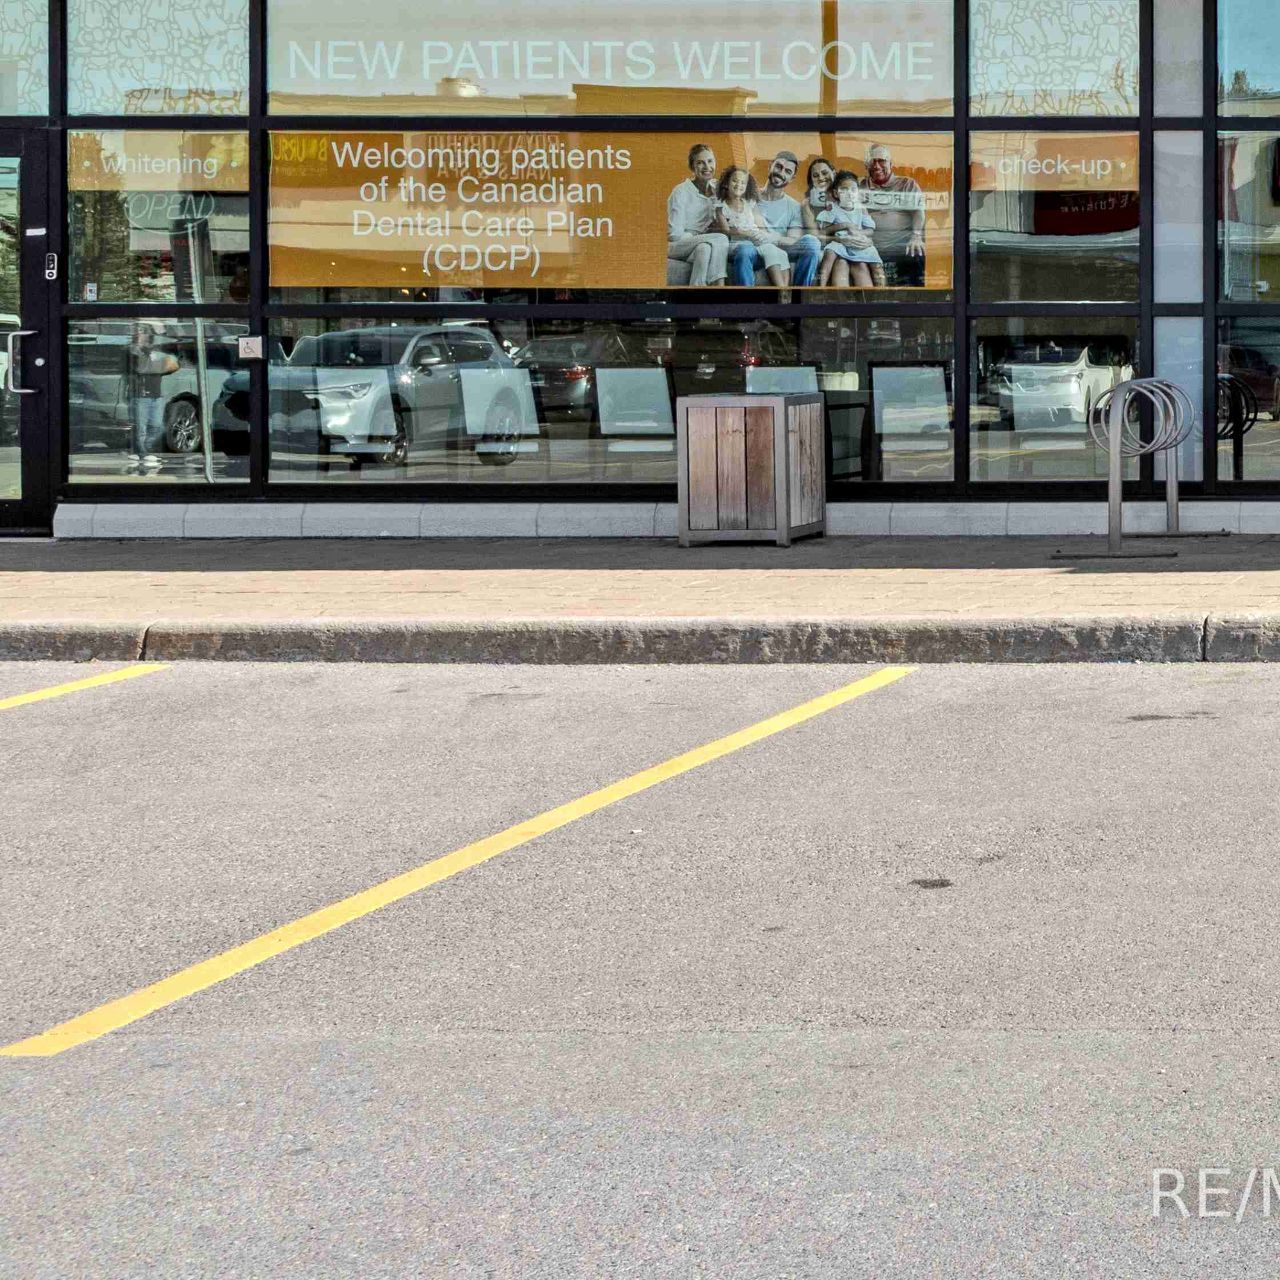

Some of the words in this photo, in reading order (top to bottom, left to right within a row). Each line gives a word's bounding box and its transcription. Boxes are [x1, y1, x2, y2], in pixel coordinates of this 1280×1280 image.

[288, 40, 403, 80] NEW
[422, 40, 656, 80] PATIENTS
[672, 40, 935, 80] WELCOME
[102, 153, 218, 178] whitening
[331, 141, 501, 174] Welcoming
[511, 142, 632, 176] patients
[999, 154, 1112, 180] check-up
[359, 175, 389, 203] of
[397, 176, 446, 203] the
[457, 176, 603, 204] Canadian
[129, 194, 205, 220] OPEN
[353, 210, 450, 237] Dental
[461, 210, 535, 238] Care
[546, 211, 613, 238] Plan
[422, 244, 541, 276] (CDCP)
